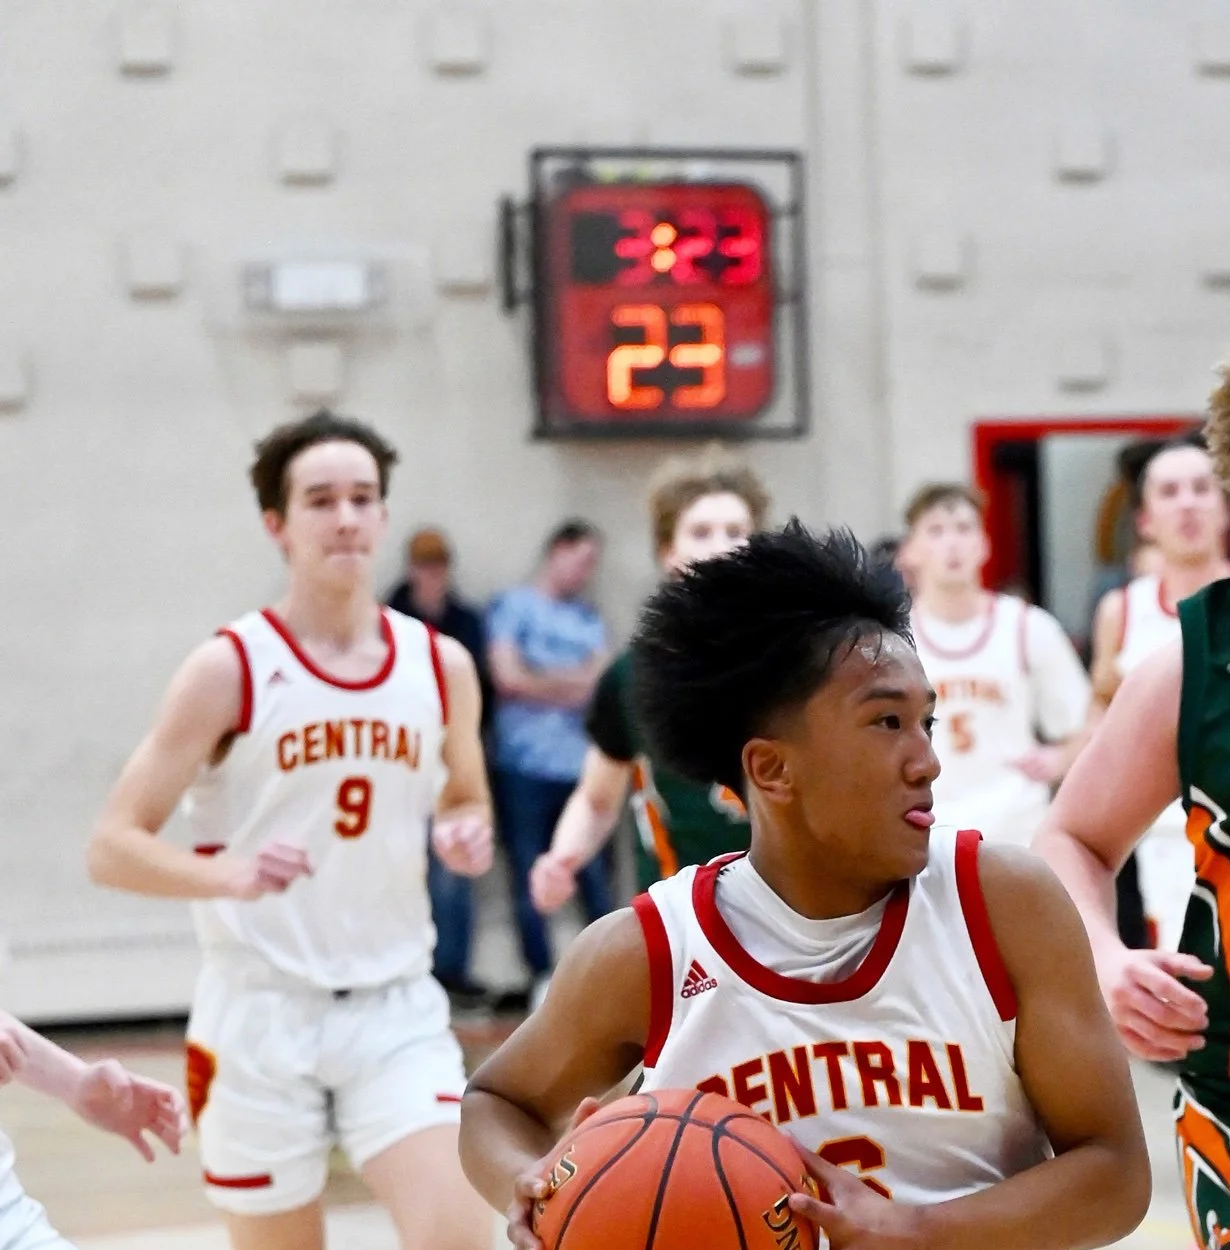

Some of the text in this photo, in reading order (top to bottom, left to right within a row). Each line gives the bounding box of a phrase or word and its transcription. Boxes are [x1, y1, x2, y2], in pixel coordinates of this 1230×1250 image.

[606, 303, 726, 408] 23
[333, 775, 374, 840] 9
[680, 975, 718, 1000] adidas
